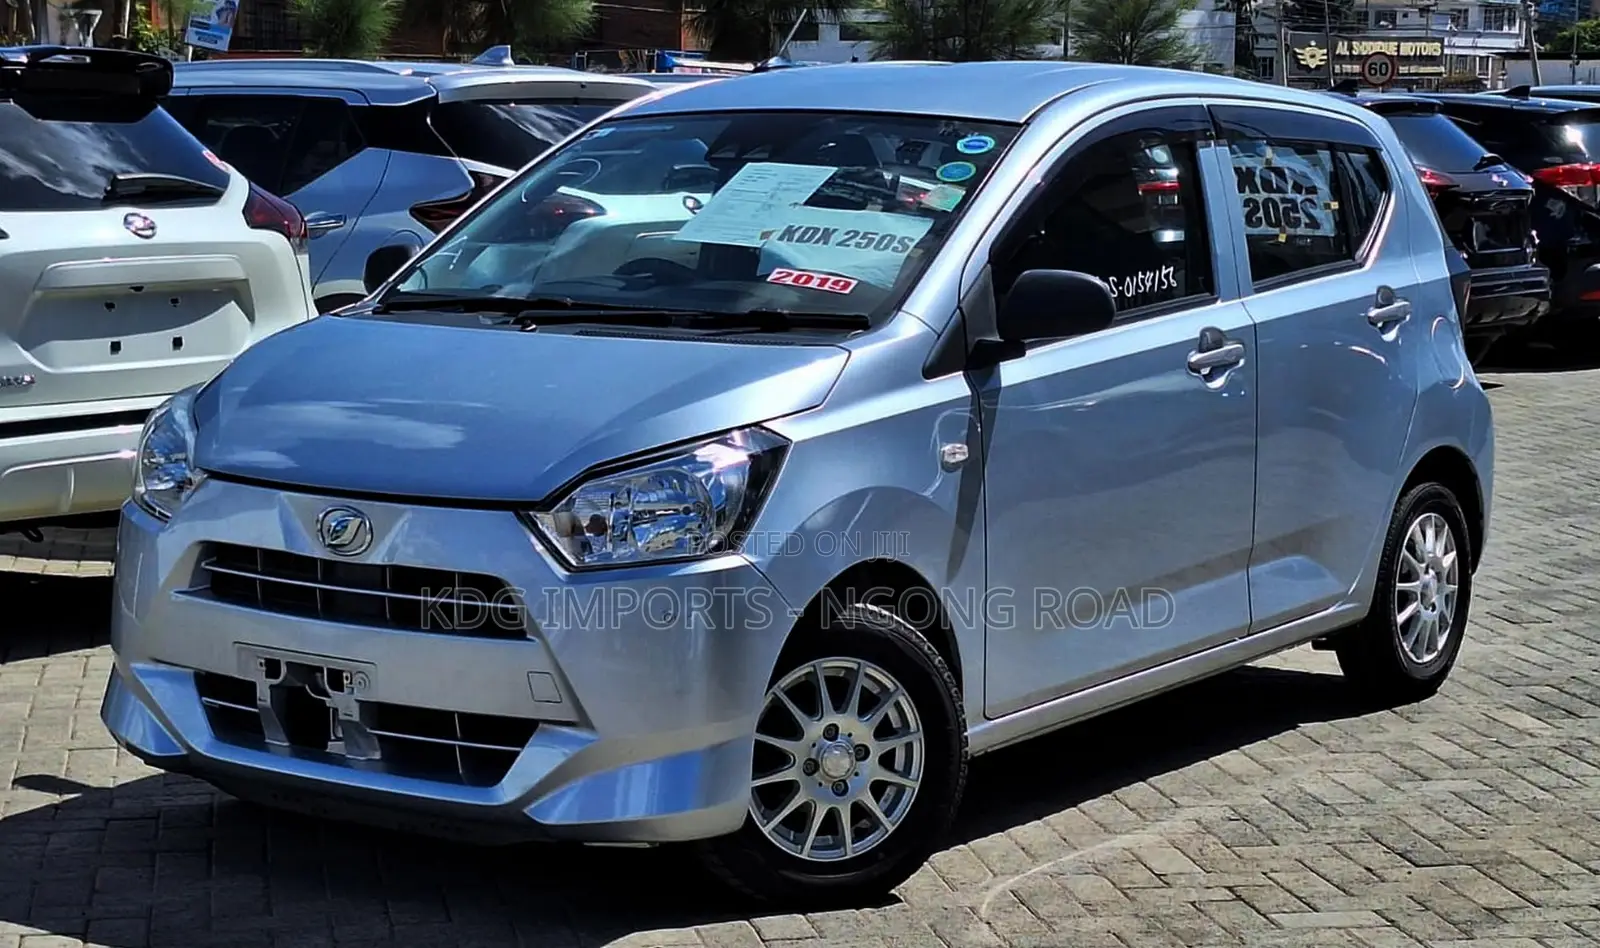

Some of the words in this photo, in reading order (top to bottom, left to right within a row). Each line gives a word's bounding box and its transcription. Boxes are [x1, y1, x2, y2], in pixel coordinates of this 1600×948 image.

[1399, 41, 1442, 56] MOTORS
[1368, 62, 1390, 77] 60
[777, 224, 838, 247] KDX
[836, 229, 915, 254] 250S
[774, 270, 853, 292] 2019
[1102, 264, 1177, 298] S-0154156
